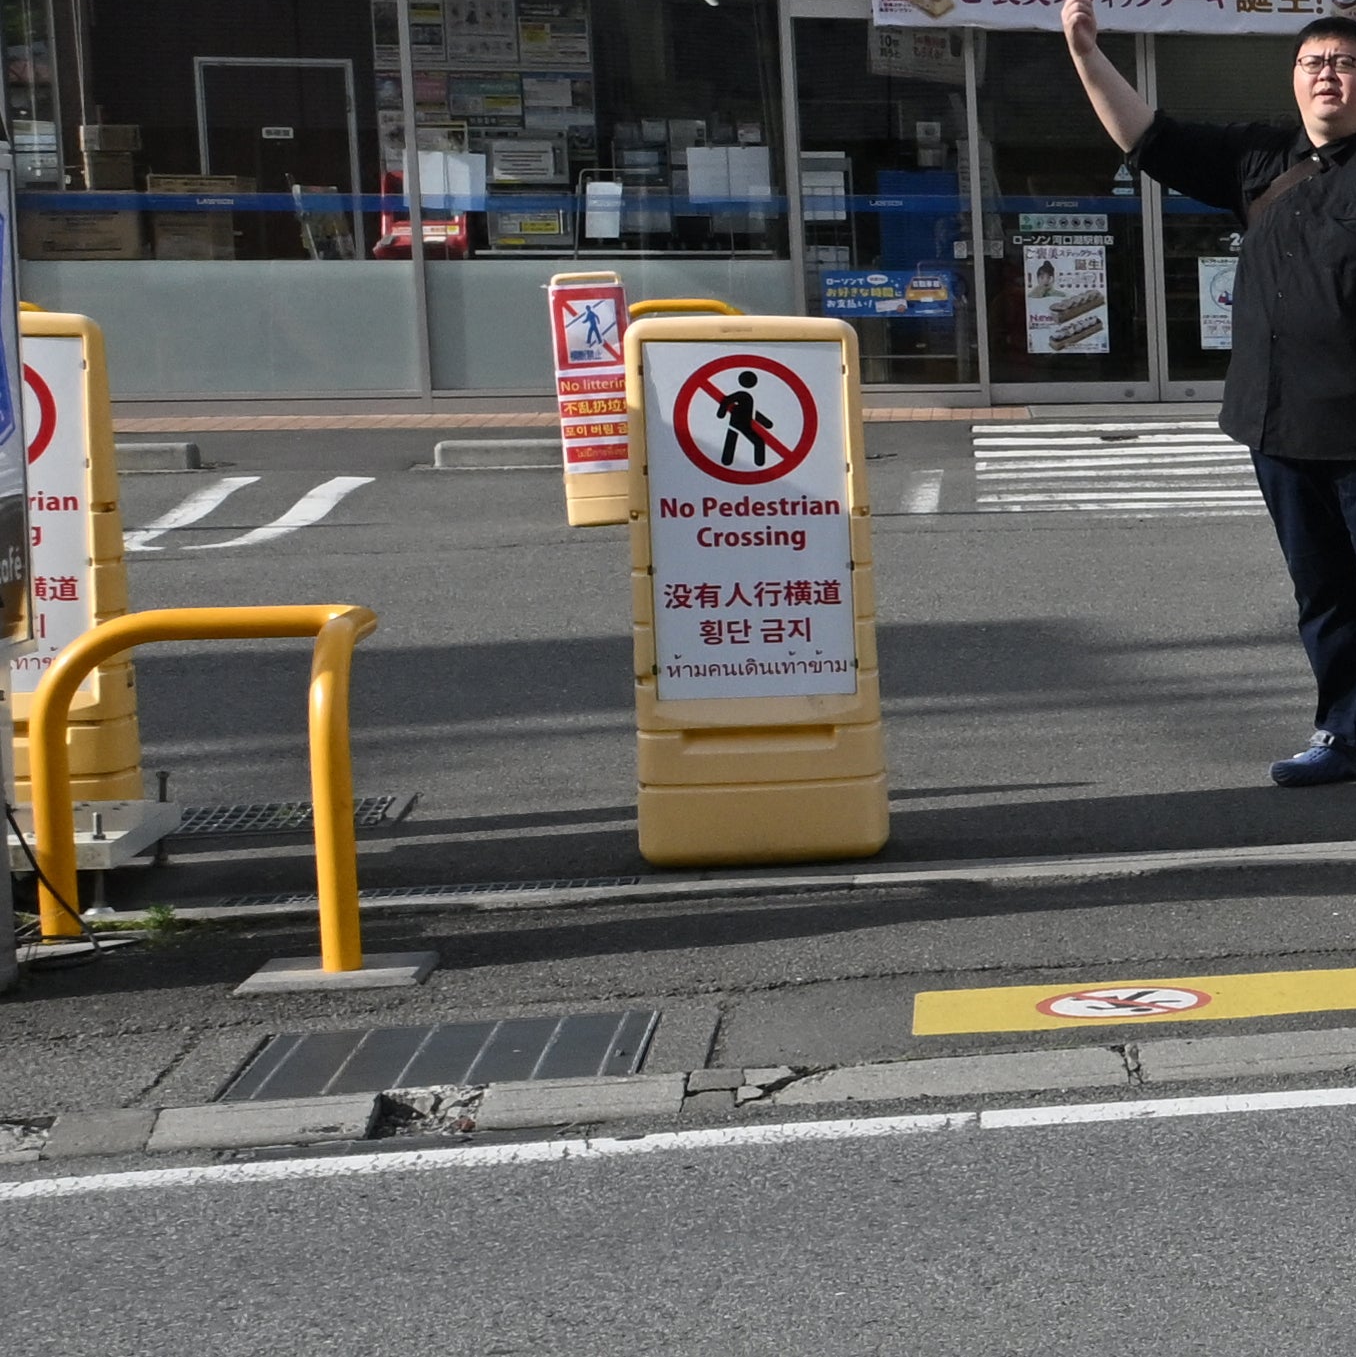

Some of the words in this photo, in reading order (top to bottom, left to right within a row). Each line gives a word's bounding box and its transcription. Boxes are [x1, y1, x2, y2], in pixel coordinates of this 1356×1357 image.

[1012, 235, 1051, 245] ローソン
[560, 380, 580, 393] No
[563, 400, 627, 416] 不乱扔垃
[660, 498, 695, 518] No
[702, 495, 841, 518] Pedestrian
[696, 525, 807, 551] Crossing
[663, 579, 842, 610] 没有人行横道
[699, 618, 753, 646] 횡단
[760, 616, 812, 643] 금지
[666, 649, 848, 678] ห้ามคนเดินเท้าข้าม
